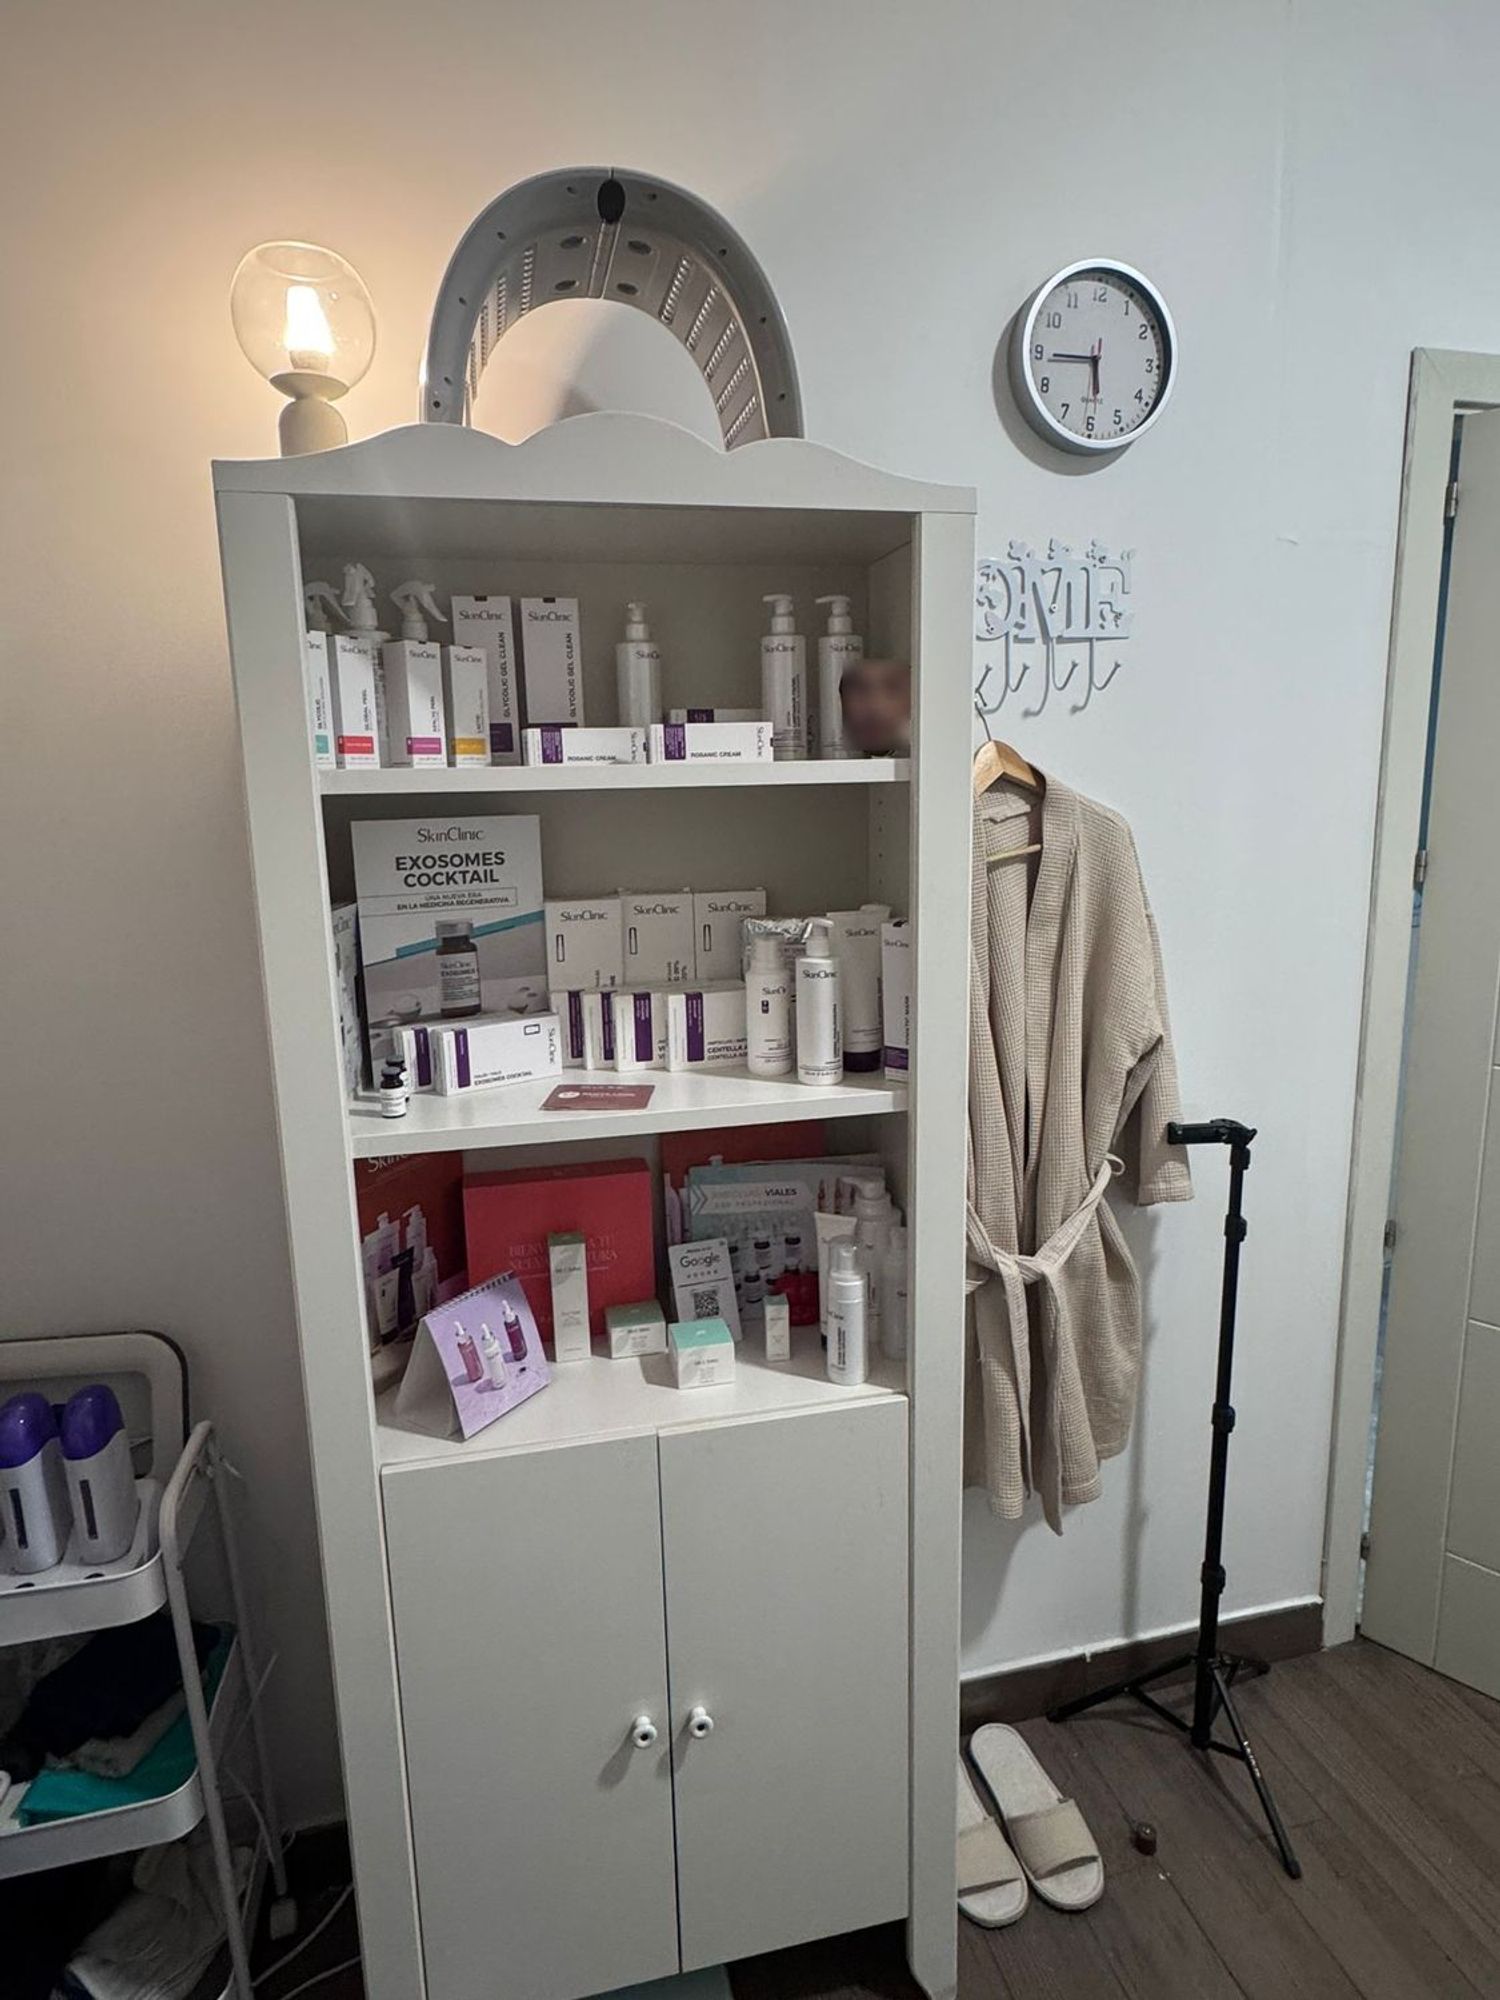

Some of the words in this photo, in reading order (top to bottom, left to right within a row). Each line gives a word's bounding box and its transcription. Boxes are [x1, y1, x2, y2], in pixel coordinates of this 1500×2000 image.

[1067, 292, 1079, 309] 11
[1092, 287, 1107, 303] 12
[1123, 300, 1130, 316] 1
[1046, 312, 1062, 329] 10
[1139, 324, 1148, 340] 2
[1034, 344, 1044, 360] 9
[1145, 358, 1153, 373] 3
[1040, 377, 1049, 393] 8
[1134, 388, 1143, 404] 4
[1061, 403, 1070, 419] 7
[1113, 410, 1122, 425] 5
[1086, 416, 1095, 431] 6
[567, 657, 575, 676] GEL
[569, 677, 577, 718] GLYCOLIC
[417, 826, 485, 843] SkinClinic
[395, 851, 506, 871] EXOSOMES
[403, 868, 500, 888] COCKTAIL
[633, 903, 680, 915] SkinClinic
[708, 900, 753, 913] SkinClinic
[560, 910, 608, 922] SkinClinic
[765, 1188, 797, 1196] VIALES
[680, 1252, 721, 1268] Google
